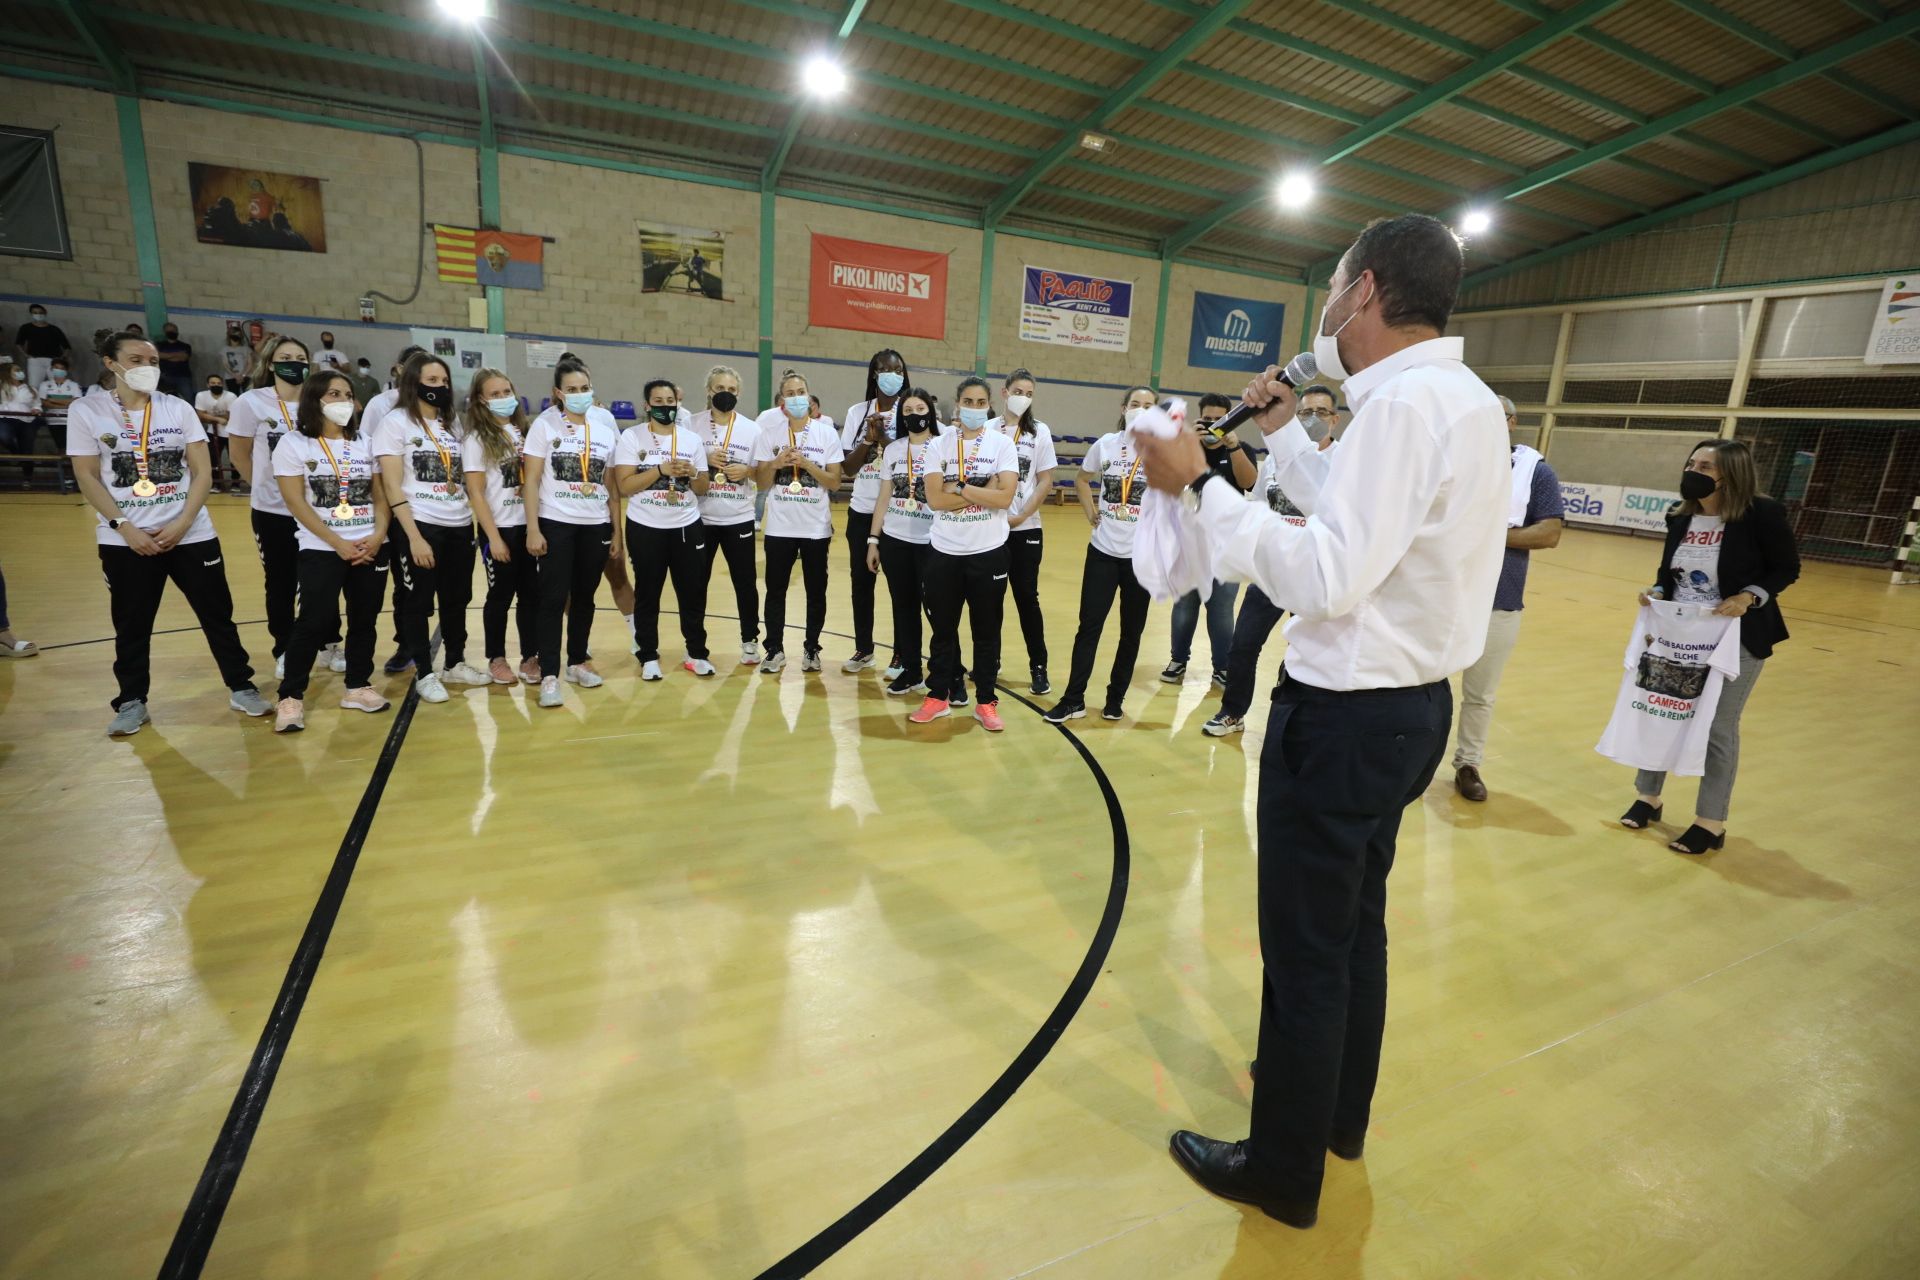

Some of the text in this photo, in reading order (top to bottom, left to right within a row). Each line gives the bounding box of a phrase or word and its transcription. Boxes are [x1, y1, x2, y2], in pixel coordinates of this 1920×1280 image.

[833, 264, 906, 293] PIKOLINOS
[847, 299, 912, 313] www.pikolinos.com
[1076, 303, 1092, 312] RENT
[1098, 305, 1111, 313] CAR
[1205, 336, 1265, 356] mustang
[1877, 336, 1920, 347] DEPOR
[1562, 494, 1604, 516] esla
[1618, 515, 1668, 529] www.supr
[1671, 641, 1719, 652] BALONMAN
[1673, 652, 1700, 661] ELCHE
[1631, 700, 1648, 713] COPA
[1648, 706, 1660, 716] de
[1659, 709, 1667, 718] la
